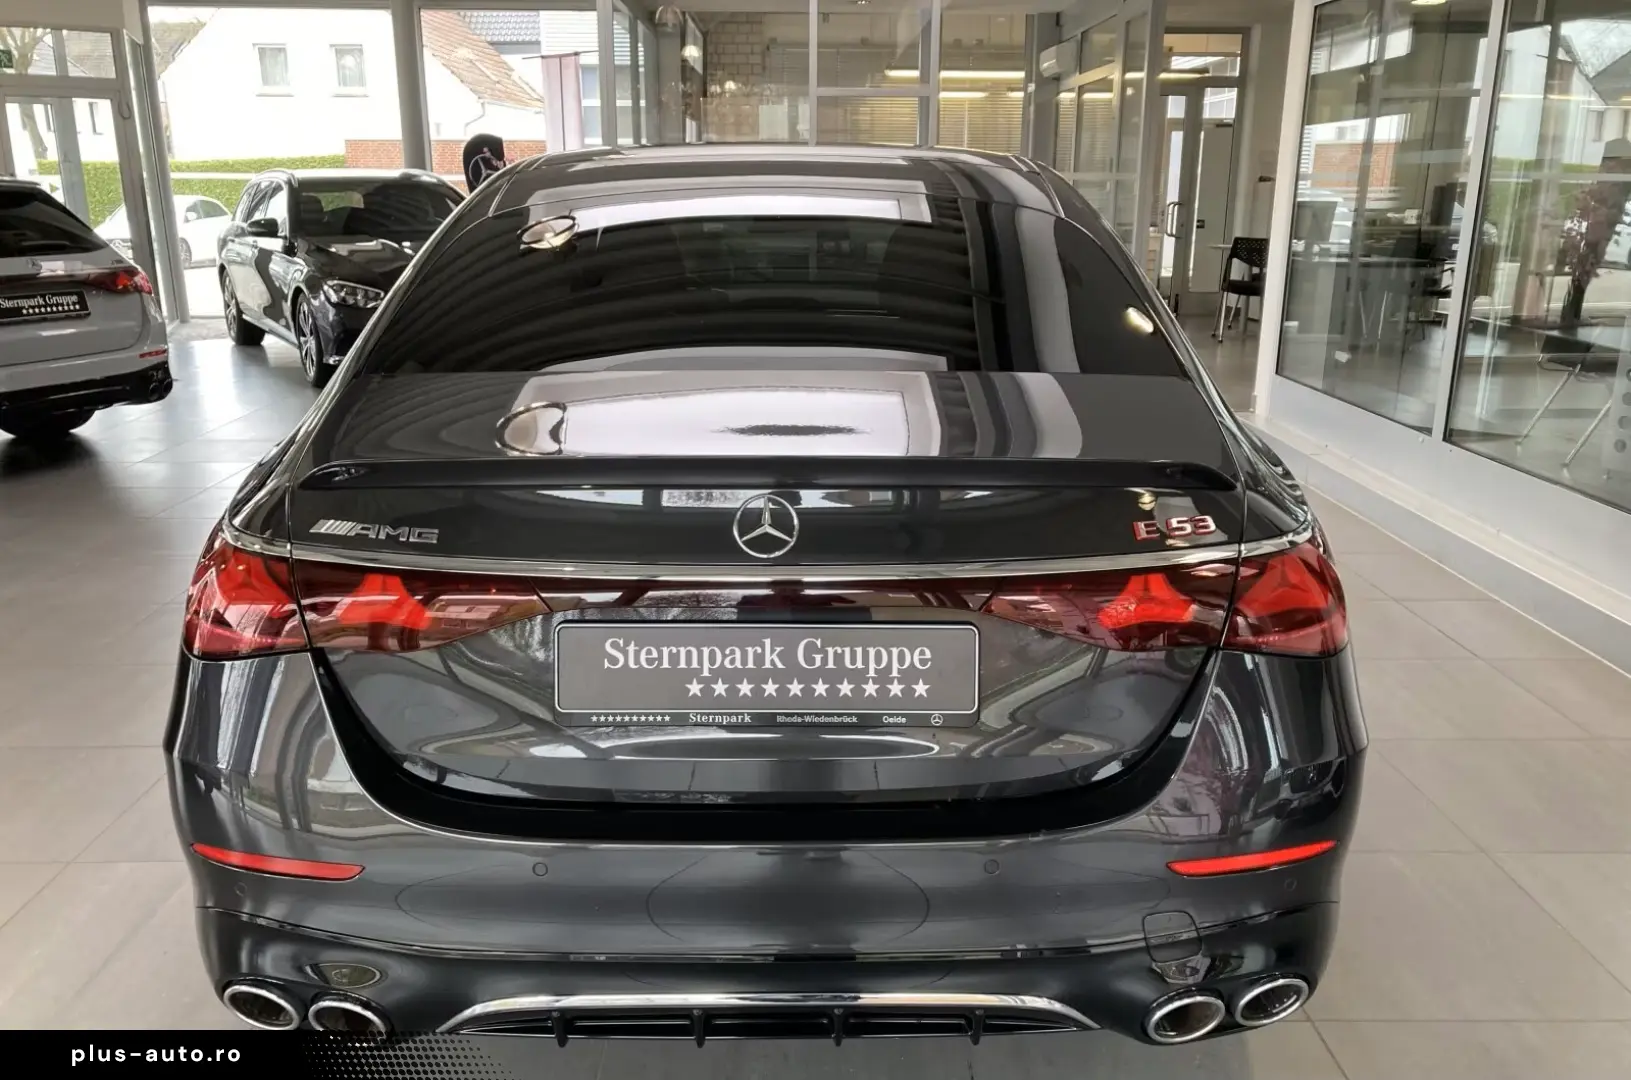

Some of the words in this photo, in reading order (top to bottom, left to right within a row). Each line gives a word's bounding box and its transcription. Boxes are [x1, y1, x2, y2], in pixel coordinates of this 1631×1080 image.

[0, 295, 45, 309] Sternpark
[45, 294, 79, 305] Gruppe
[346, 522, 440, 544] AMG
[1132, 520, 1161, 541] E
[1165, 515, 1217, 538] 53
[603, 637, 786, 677] Sternpark
[796, 637, 932, 677] Gruppe
[688, 712, 752, 724] Sternpark
